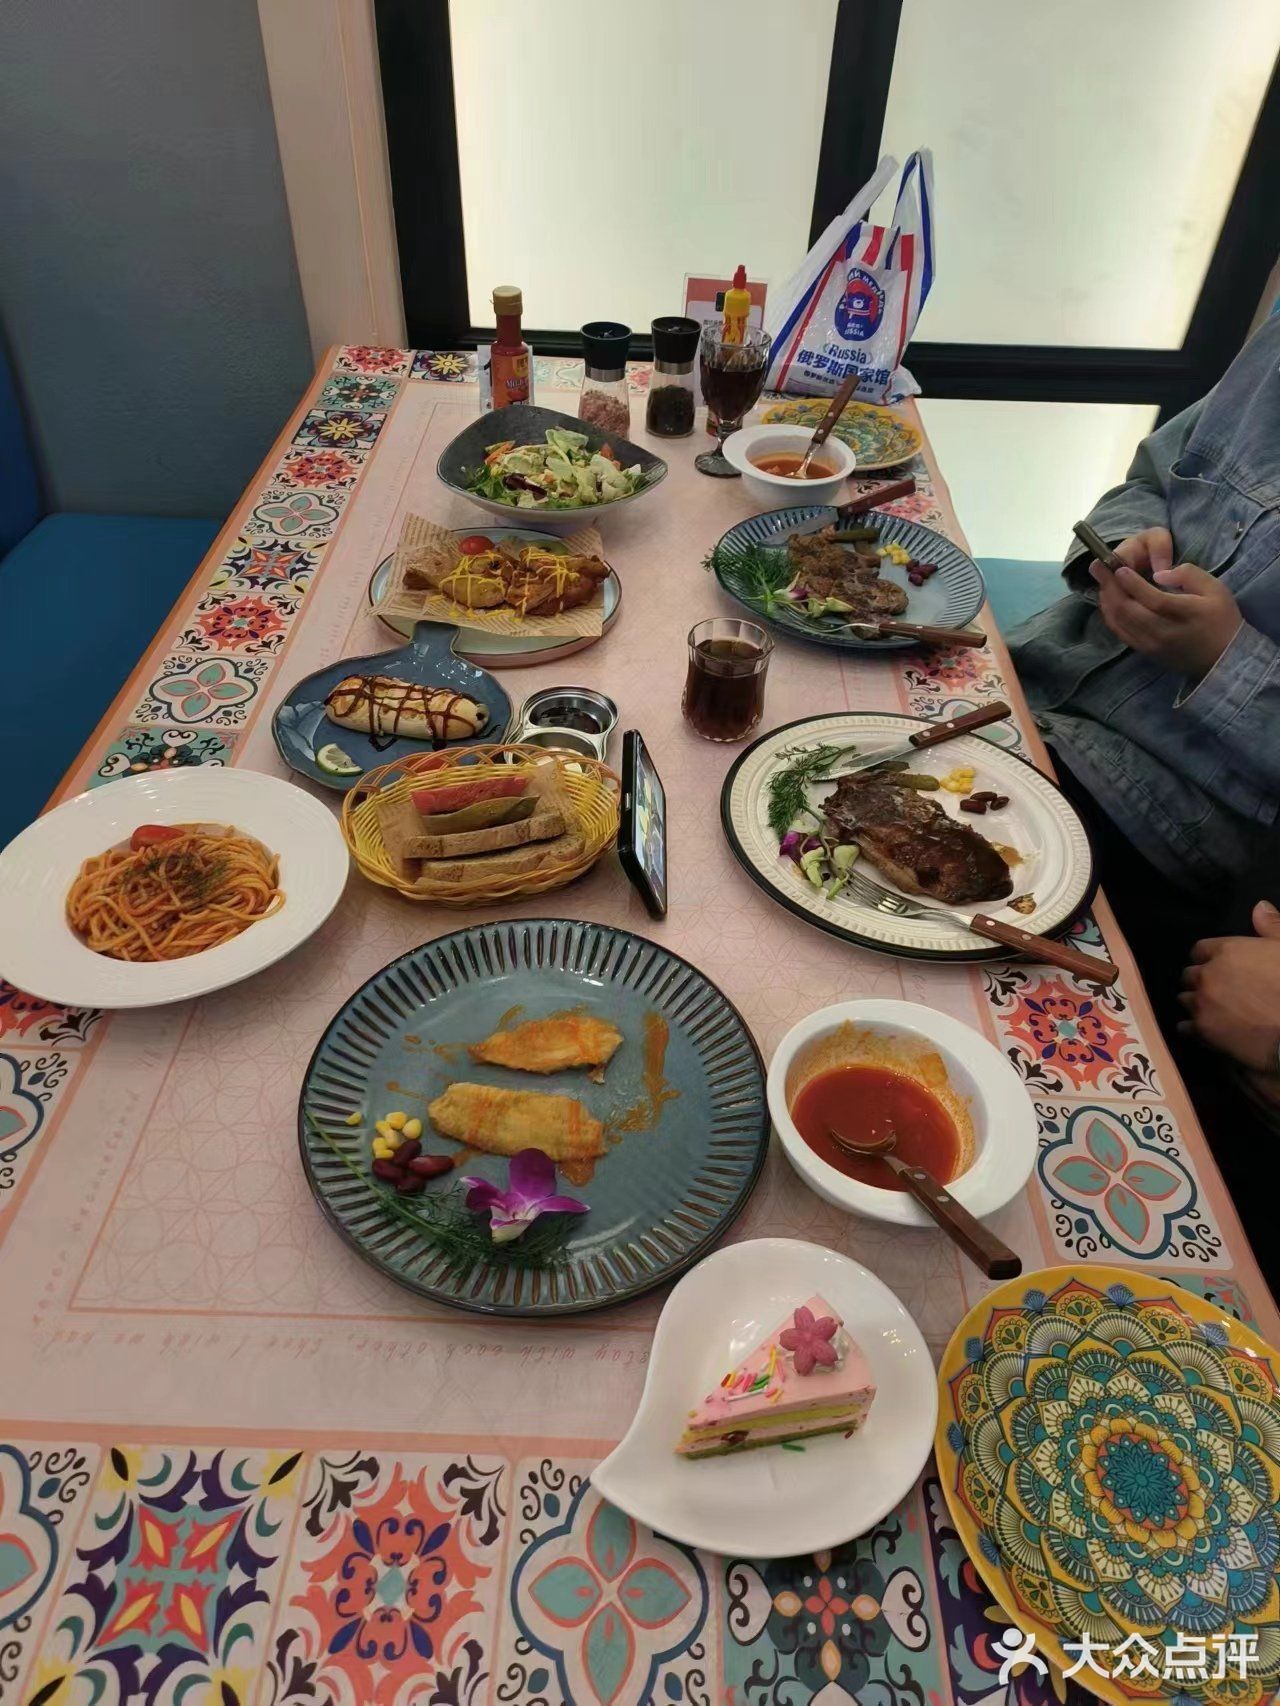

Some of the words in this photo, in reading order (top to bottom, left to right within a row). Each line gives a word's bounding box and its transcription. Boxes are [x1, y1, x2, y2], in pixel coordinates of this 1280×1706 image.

[797, 349, 891, 386] 俄罗斯国家馆
